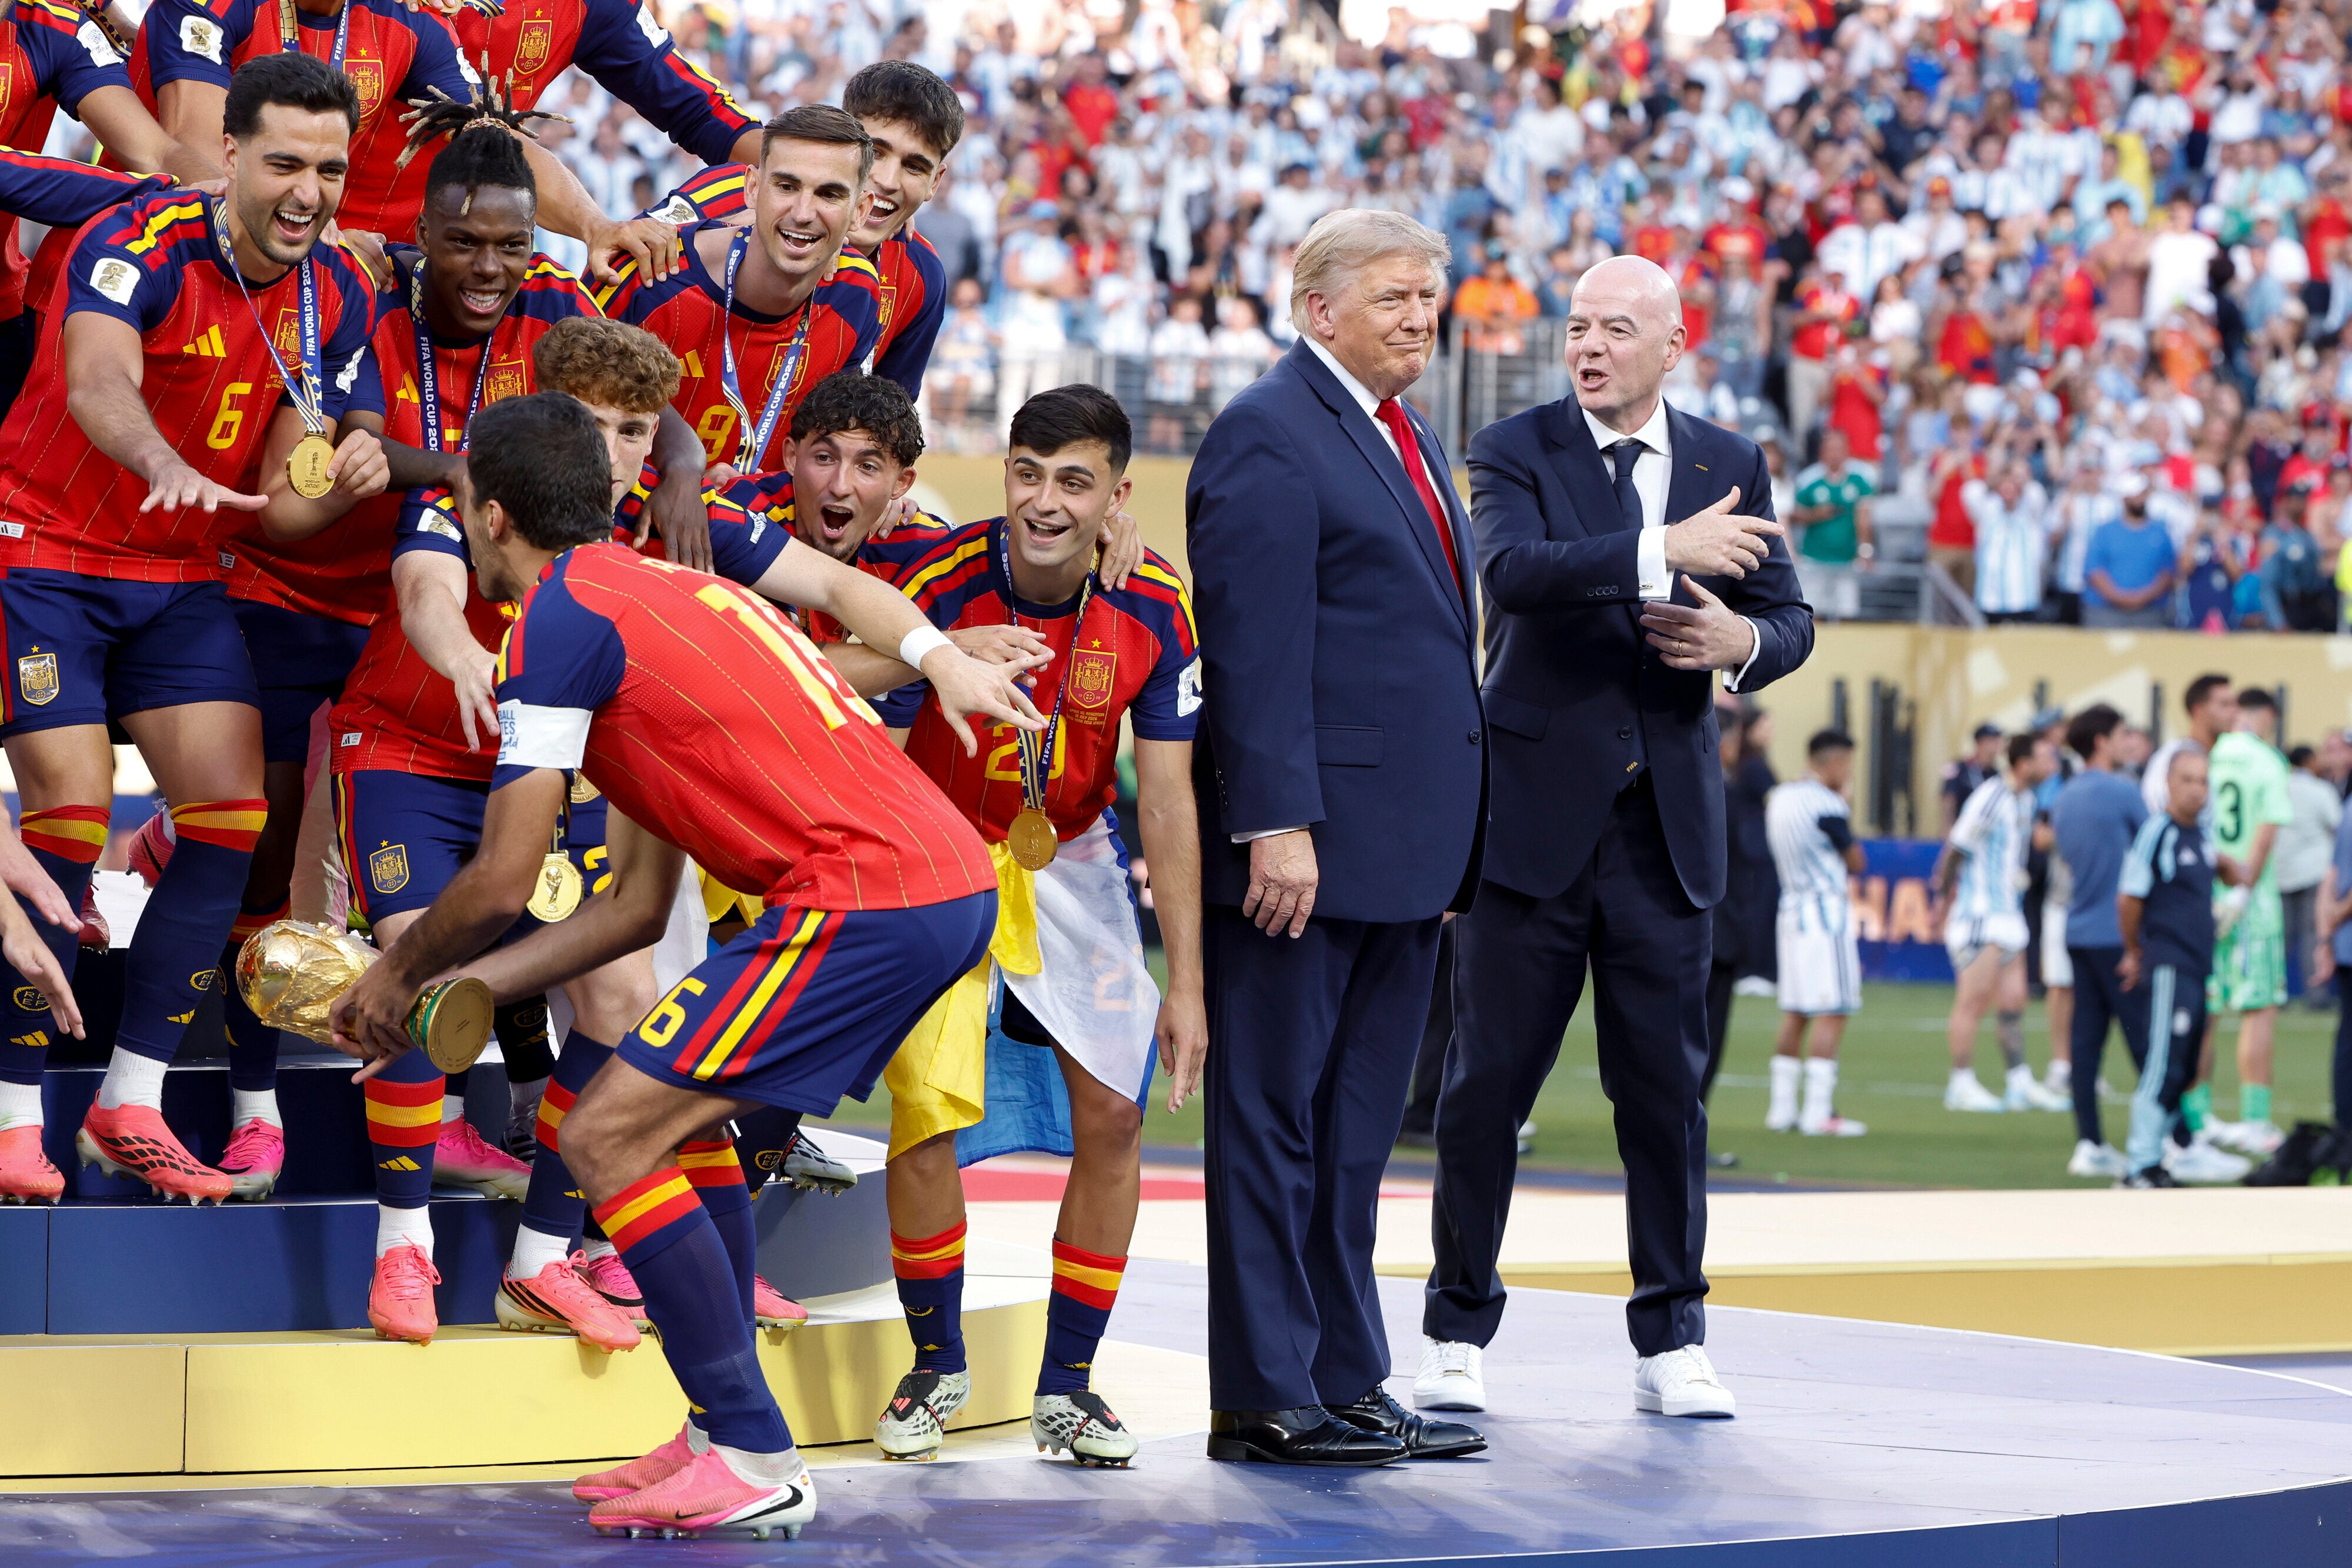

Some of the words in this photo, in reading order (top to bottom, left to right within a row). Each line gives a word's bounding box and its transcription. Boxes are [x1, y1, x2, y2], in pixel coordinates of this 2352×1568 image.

[334, 38, 343, 61] FIFA
[727, 249, 741, 285] 2026
[303, 286, 312, 302] CUP
[305, 301, 315, 333] WORLD
[306, 333, 316, 356] FIFA
[420, 336, 430, 360] FIFA
[480, 336, 492, 375] 2026
[422, 361, 435, 402] WORLD
[207, 382, 253, 449] 6
[426, 403, 436, 426] CUP
[756, 410, 775, 443] WORLD
[770, 390, 781, 409] CUP
[778, 355, 796, 390] 2026
[1002, 552, 1012, 591] 2026
[984, 714, 1067, 782] 20
[1041, 741, 1052, 765] FIFA
[1047, 700, 1060, 740] WORLD
[1626, 761, 1638, 773] FIFA
[574, 790, 598, 802] CHAMPIO
[629, 976, 708, 1048] 6
[780, 1136, 799, 1164] PREDATOR
